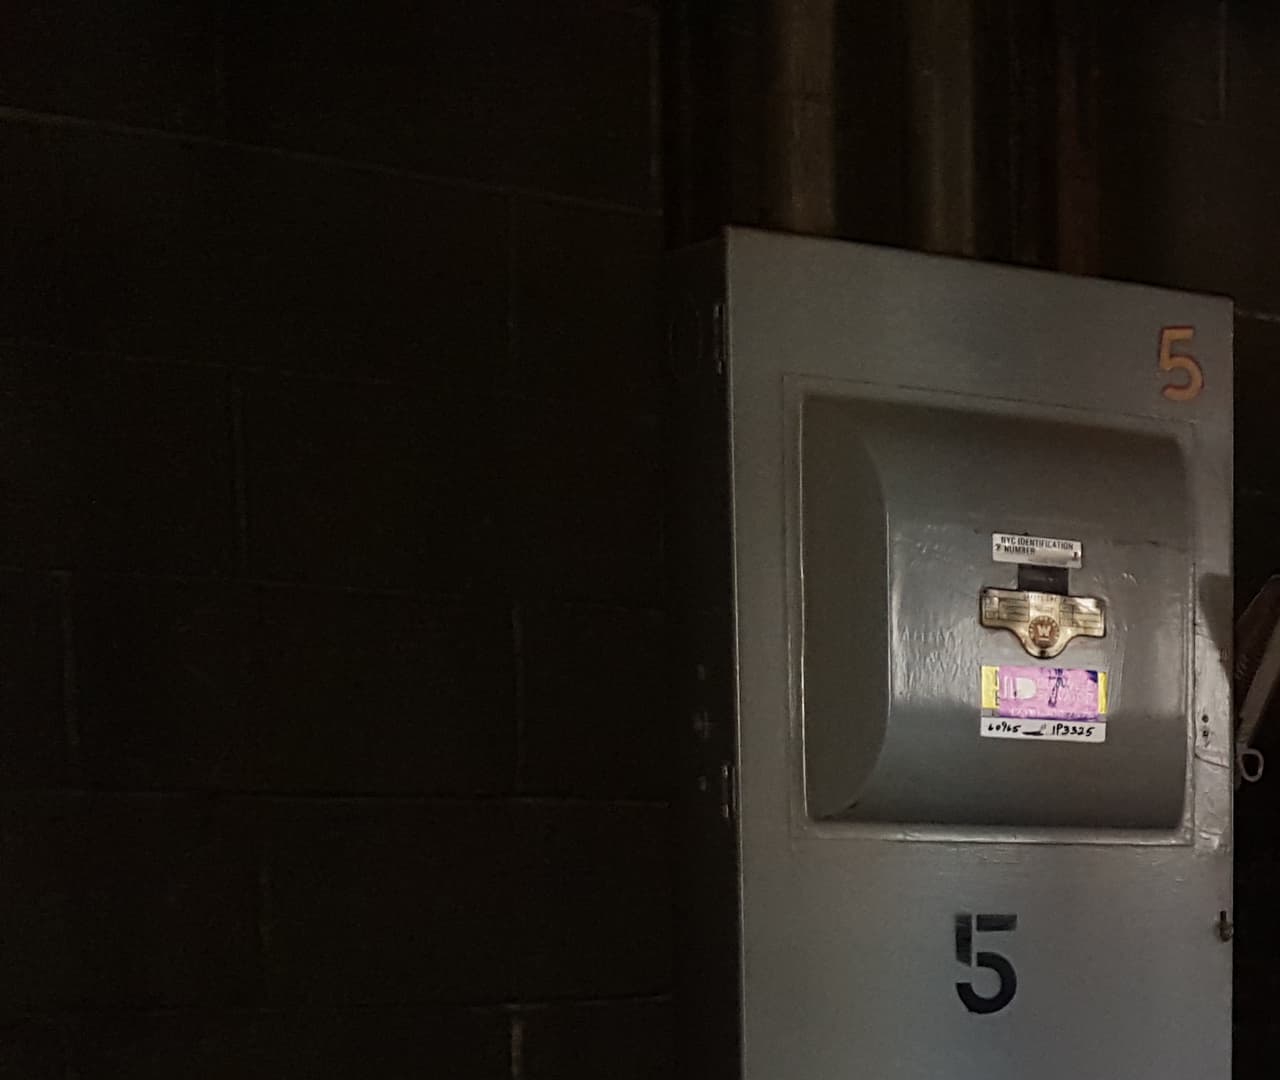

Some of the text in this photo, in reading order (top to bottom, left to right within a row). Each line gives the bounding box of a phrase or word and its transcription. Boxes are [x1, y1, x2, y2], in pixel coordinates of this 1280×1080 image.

[1159, 325, 1204, 400] 5
[1001, 536, 1074, 551] NYC IDENTIFICATION
[1004, 546, 1036, 555] NUMBER
[955, 914, 1017, 1014] 5
